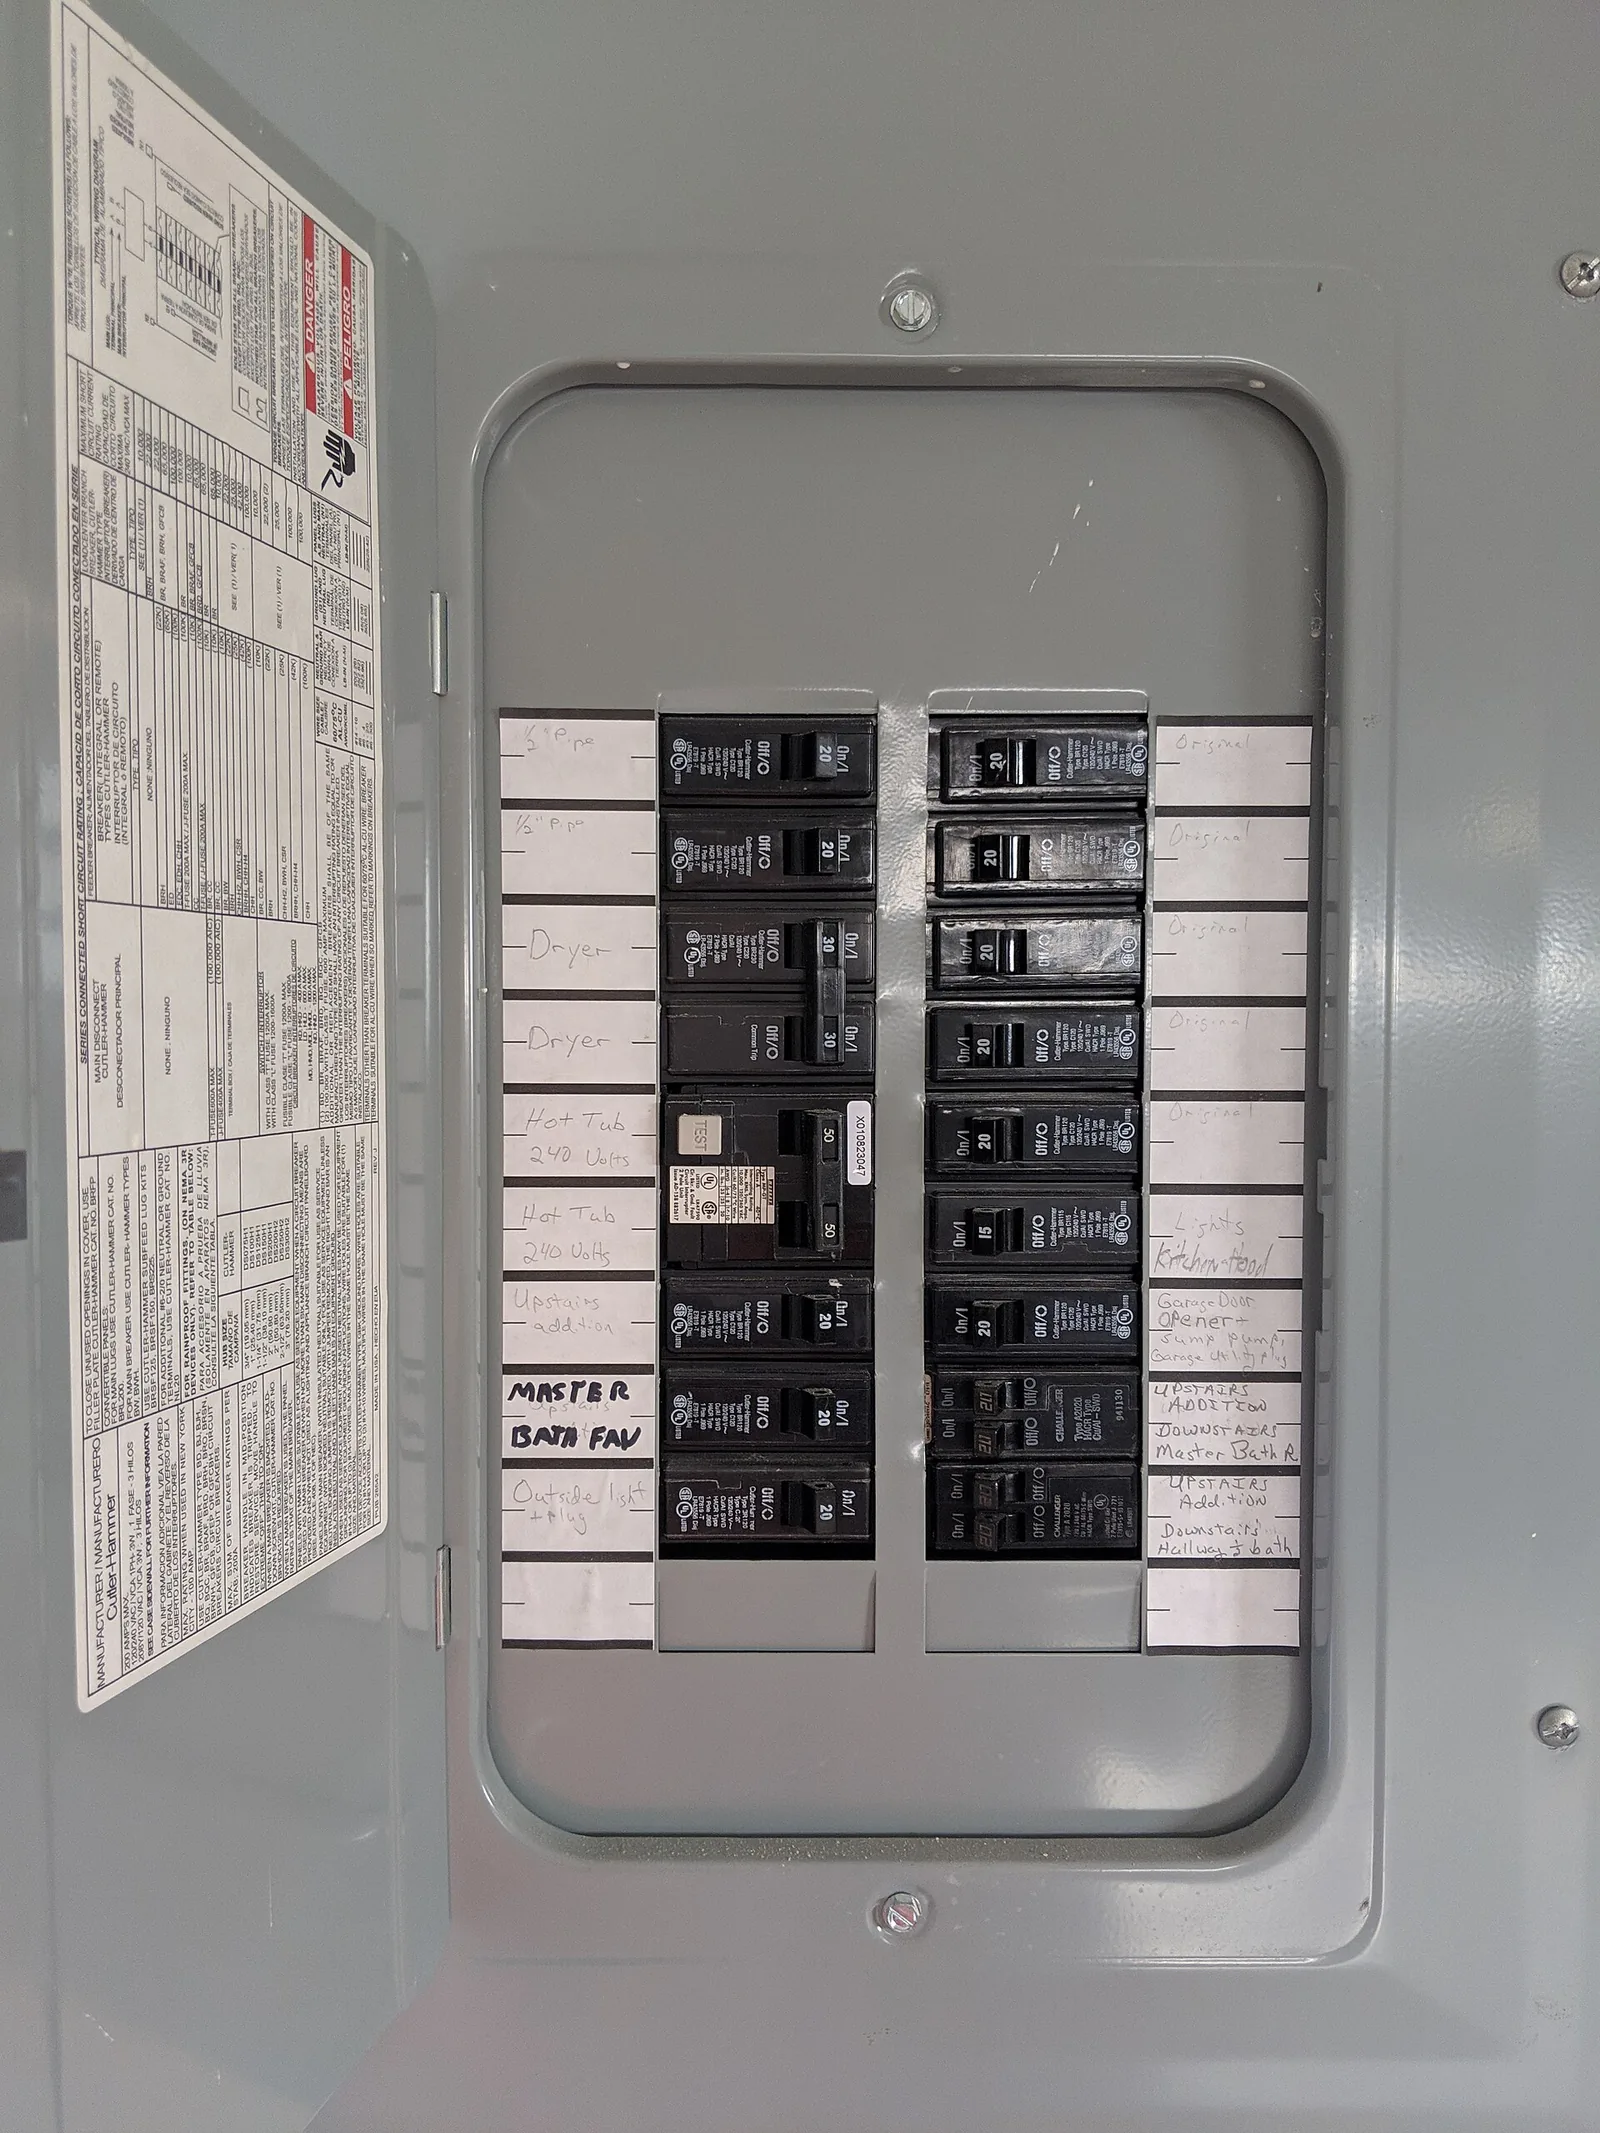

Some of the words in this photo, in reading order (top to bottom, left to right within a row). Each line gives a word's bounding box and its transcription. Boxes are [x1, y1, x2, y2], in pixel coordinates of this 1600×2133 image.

[305, 258, 314, 344] DANGER
[342, 286, 351, 370] PELIGRO
[70, 464, 78, 502] SERIE
[71, 504, 79, 521] EN
[71, 524, 80, 601] CONECTADO
[72, 605, 80, 663] CIRCUITO
[73, 666, 81, 704] CORTO
[73, 711, 81, 729] DE
[819, 745, 832, 763] 20
[1175, 733, 1249, 754] Original
[74, 733, 82, 787] CAPACID
[744, 739, 752, 780] Cutler-Hammer
[990, 752, 1003, 769] 20
[75, 797, 84, 839] RATING
[1169, 820, 1249, 849] Original
[745, 836, 753, 877] Cutler-Hammer
[822, 841, 834, 858] 20
[984, 850, 997, 866] 20
[76, 841, 85, 893] CIRCUIT
[77, 895, 86, 936] SHORT
[1169, 914, 1247, 940] Original
[530, 928, 611, 969] Dryer
[823, 936, 835, 953] 30
[980, 944, 993, 961] 20
[78, 941, 87, 1017] CONNECTED
[113, 954, 121, 1008] PRINCIPAL
[92, 979, 100, 1051] DISCONNECT
[1169, 1010, 1249, 1031] Original
[80, 1021, 88, 1064] SERIES
[100, 984, 108, 1079] CUTLER-HAMMER
[528, 1025, 612, 1061] Dryer
[824, 1032, 837, 1048] 30
[750, 1049, 758, 1061] Trip
[977, 1038, 990, 1055] 20
[115, 1012, 123, 1108] DESCONECTADOR
[526, 1108, 573, 1131] Hot
[583, 1112, 626, 1131] Tub
[1170, 1102, 1251, 1124] Original
[694, 1119, 707, 1152] TEST
[824, 1127, 835, 1143] 50
[855, 1115, 866, 1177] X010823047
[978, 1133, 991, 1150] 20
[530, 1146, 571, 1164] 240
[586, 1148, 630, 1167] Volts
[522, 1204, 562, 1226] Hot
[569, 1206, 616, 1223] Tub
[1175, 1208, 1245, 1238] Lights
[825, 1223, 836, 1238] 50
[979, 1226, 992, 1239] 15
[524, 1242, 561, 1265] 240
[572, 1242, 611, 1268] Volts
[514, 1289, 600, 1313] Upstairs
[1157, 1293, 1215, 1313] Garage
[1219, 1291, 1256, 1308] Door
[744, 1302, 752, 1341] Cutler-Hammer
[820, 1313, 832, 1329] 20
[978, 1321, 990, 1337] 20
[1150, 1349, 1204, 1367] Garage
[507, 1380, 630, 1403] MASTER
[1092, 1393, 1100, 1412] SWD
[744, 1395, 752, 1434] Cutler-Hammer
[1074, 1398, 1082, 1421] A2020
[1083, 1399, 1092, 1417] Type
[1115, 1389, 1124, 1421] 941130
[818, 1410, 831, 1426] 20
[1083, 1419, 1091, 1440] HACR
[511, 1425, 578, 1448] BATH
[590, 1427, 642, 1451] FAV
[1074, 1423, 1083, 1441] Type
[1155, 1424, 1276, 1438] DOWNSTAIRS
[142, 1423, 150, 1489] INFORMATION
[1156, 1443, 1225, 1461] Master
[1231, 1440, 1276, 1461] Bath
[513, 1479, 600, 1505] Outside
[1170, 1475, 1268, 1492] UPSTAIRS
[91, 1439, 104, 1566] MANUFACTURERO
[143, 1491, 151, 1535] FURTHER
[819, 1504, 833, 1521] 20
[105, 1494, 118, 1621] Cutler-Hammer
[144, 1537, 152, 1557] FOR
[1249, 1535, 1292, 1557] bath
[145, 1558, 153, 1606] SIDEWALL
[95, 1573, 107, 1688] MANUFACTURER
